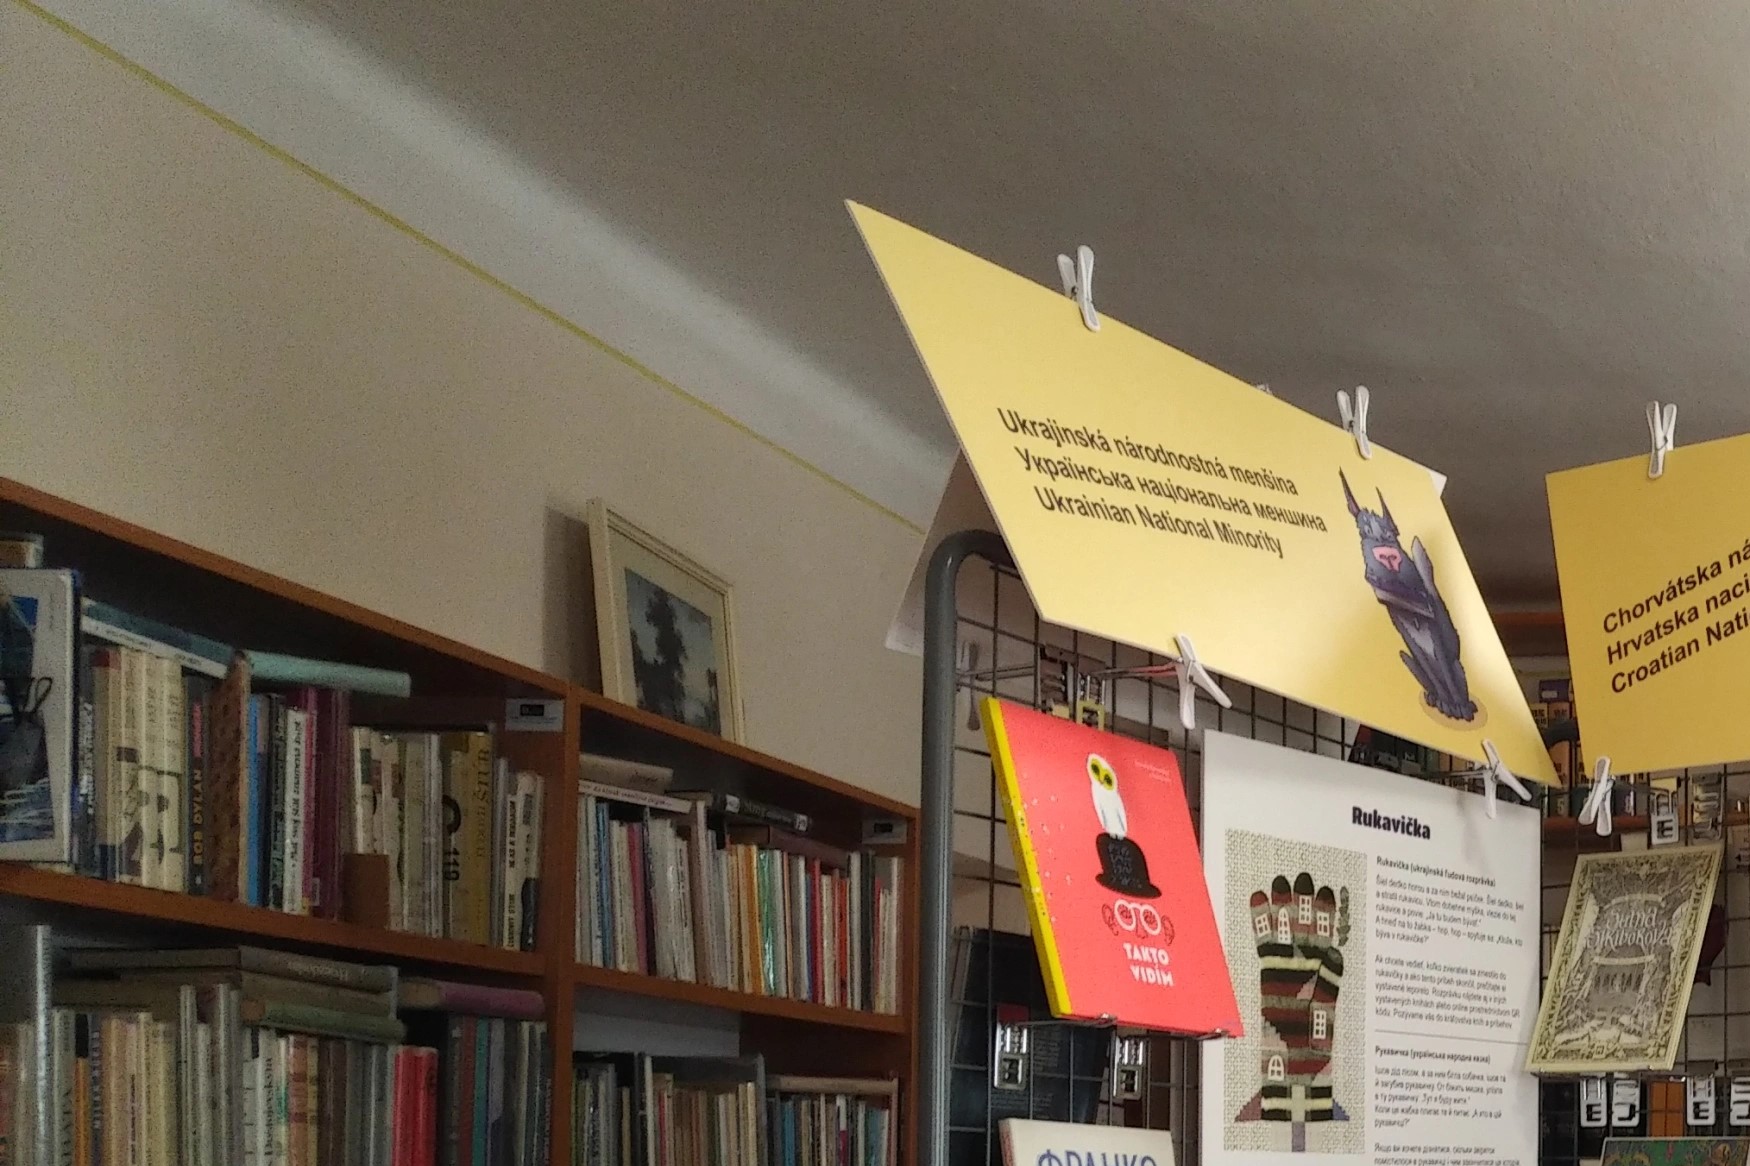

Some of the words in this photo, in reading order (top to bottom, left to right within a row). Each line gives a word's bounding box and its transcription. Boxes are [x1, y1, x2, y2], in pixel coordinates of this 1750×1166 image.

[997, 407, 1112, 453] Ukrajinská
[1113, 436, 1228, 480] národnostná
[1229, 464, 1298, 496] menšina
[1014, 445, 1136, 492] Українська
[1136, 474, 1252, 516] національна
[1253, 502, 1328, 533] меншина
[1034, 485, 1137, 526] Ukrainian
[1134, 503, 1214, 540] National
[1212, 519, 1284, 559] Minority
[1603, 562, 1722, 634] Chorvátska
[1607, 605, 1699, 665] Hrvatska
[1611, 635, 1700, 694] Croatian
[193, 768, 203, 825] DYLAN
[1352, 806, 1431, 840] Rukavička
[193, 831, 204, 865] BOB
